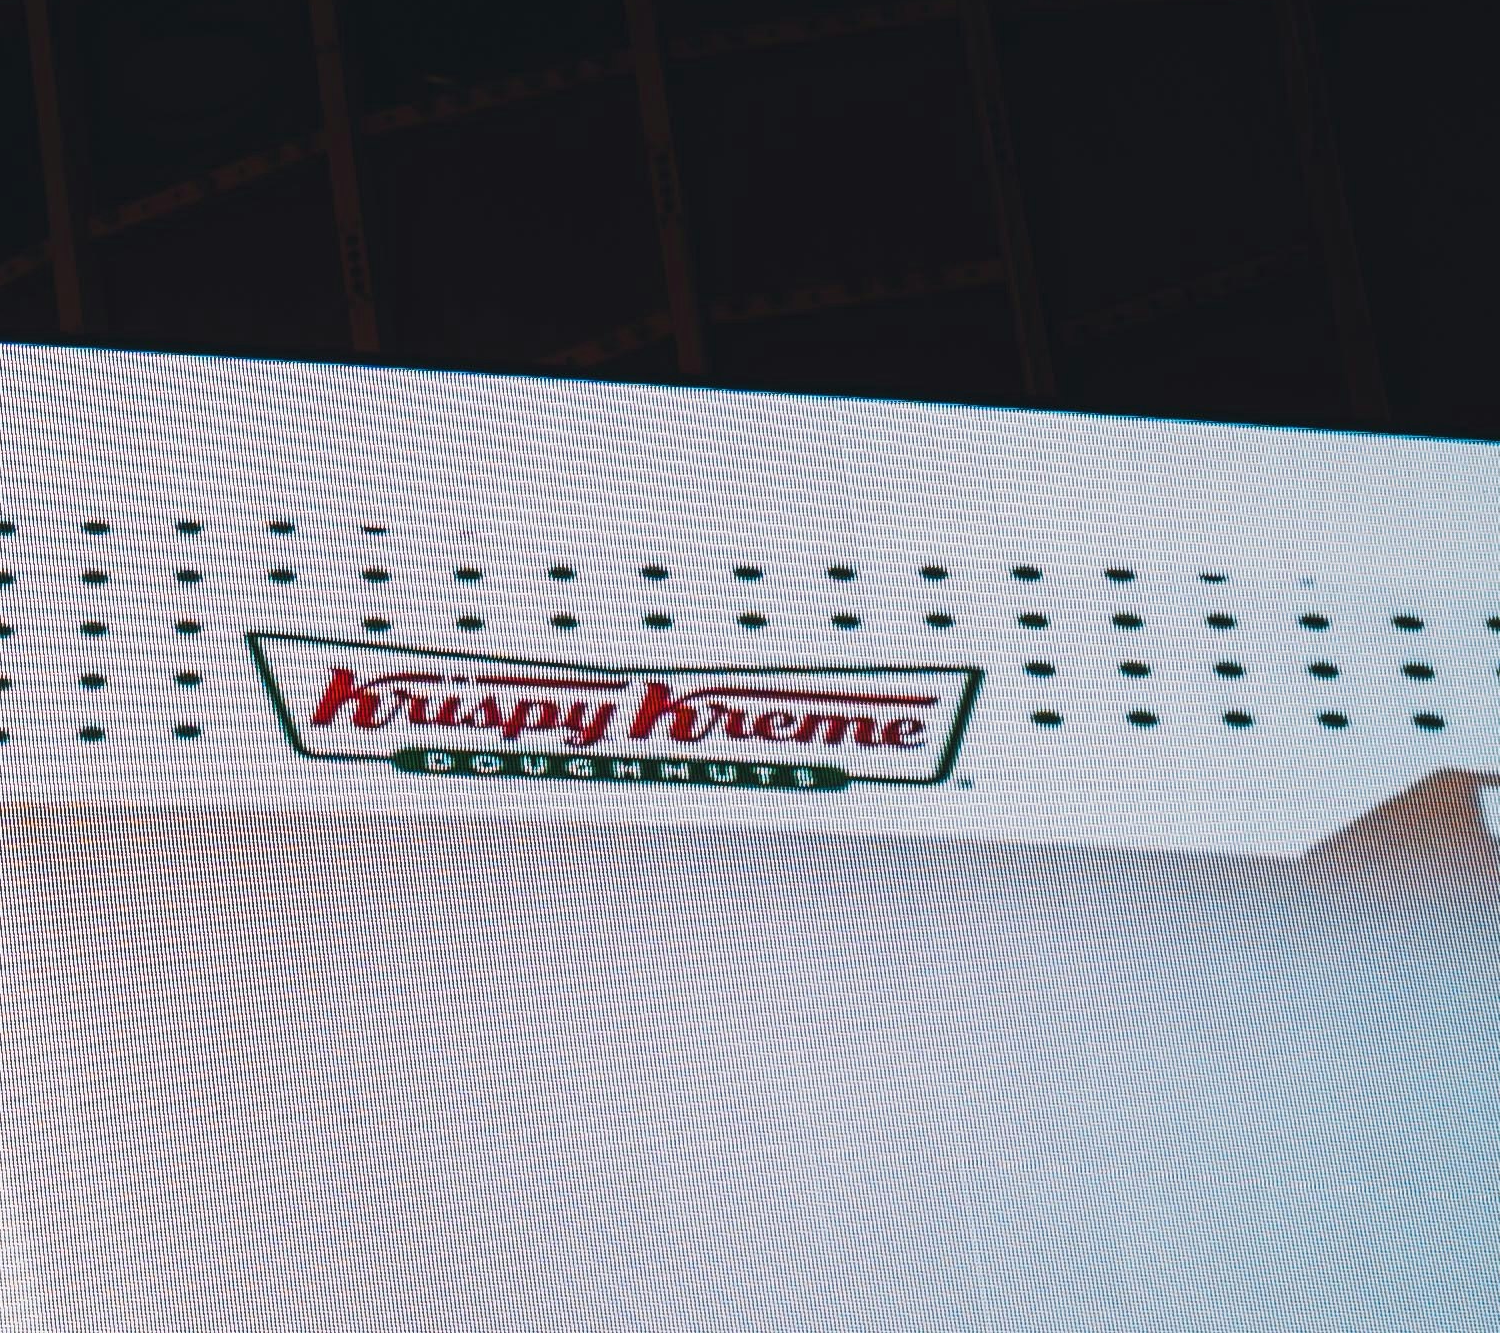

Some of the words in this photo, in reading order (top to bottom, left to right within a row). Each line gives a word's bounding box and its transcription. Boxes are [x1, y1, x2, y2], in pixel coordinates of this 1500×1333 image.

[310, 667, 626, 746] Krispy
[629, 682, 938, 748] Kreme
[423, 749, 816, 788] DOUGHNUTS
